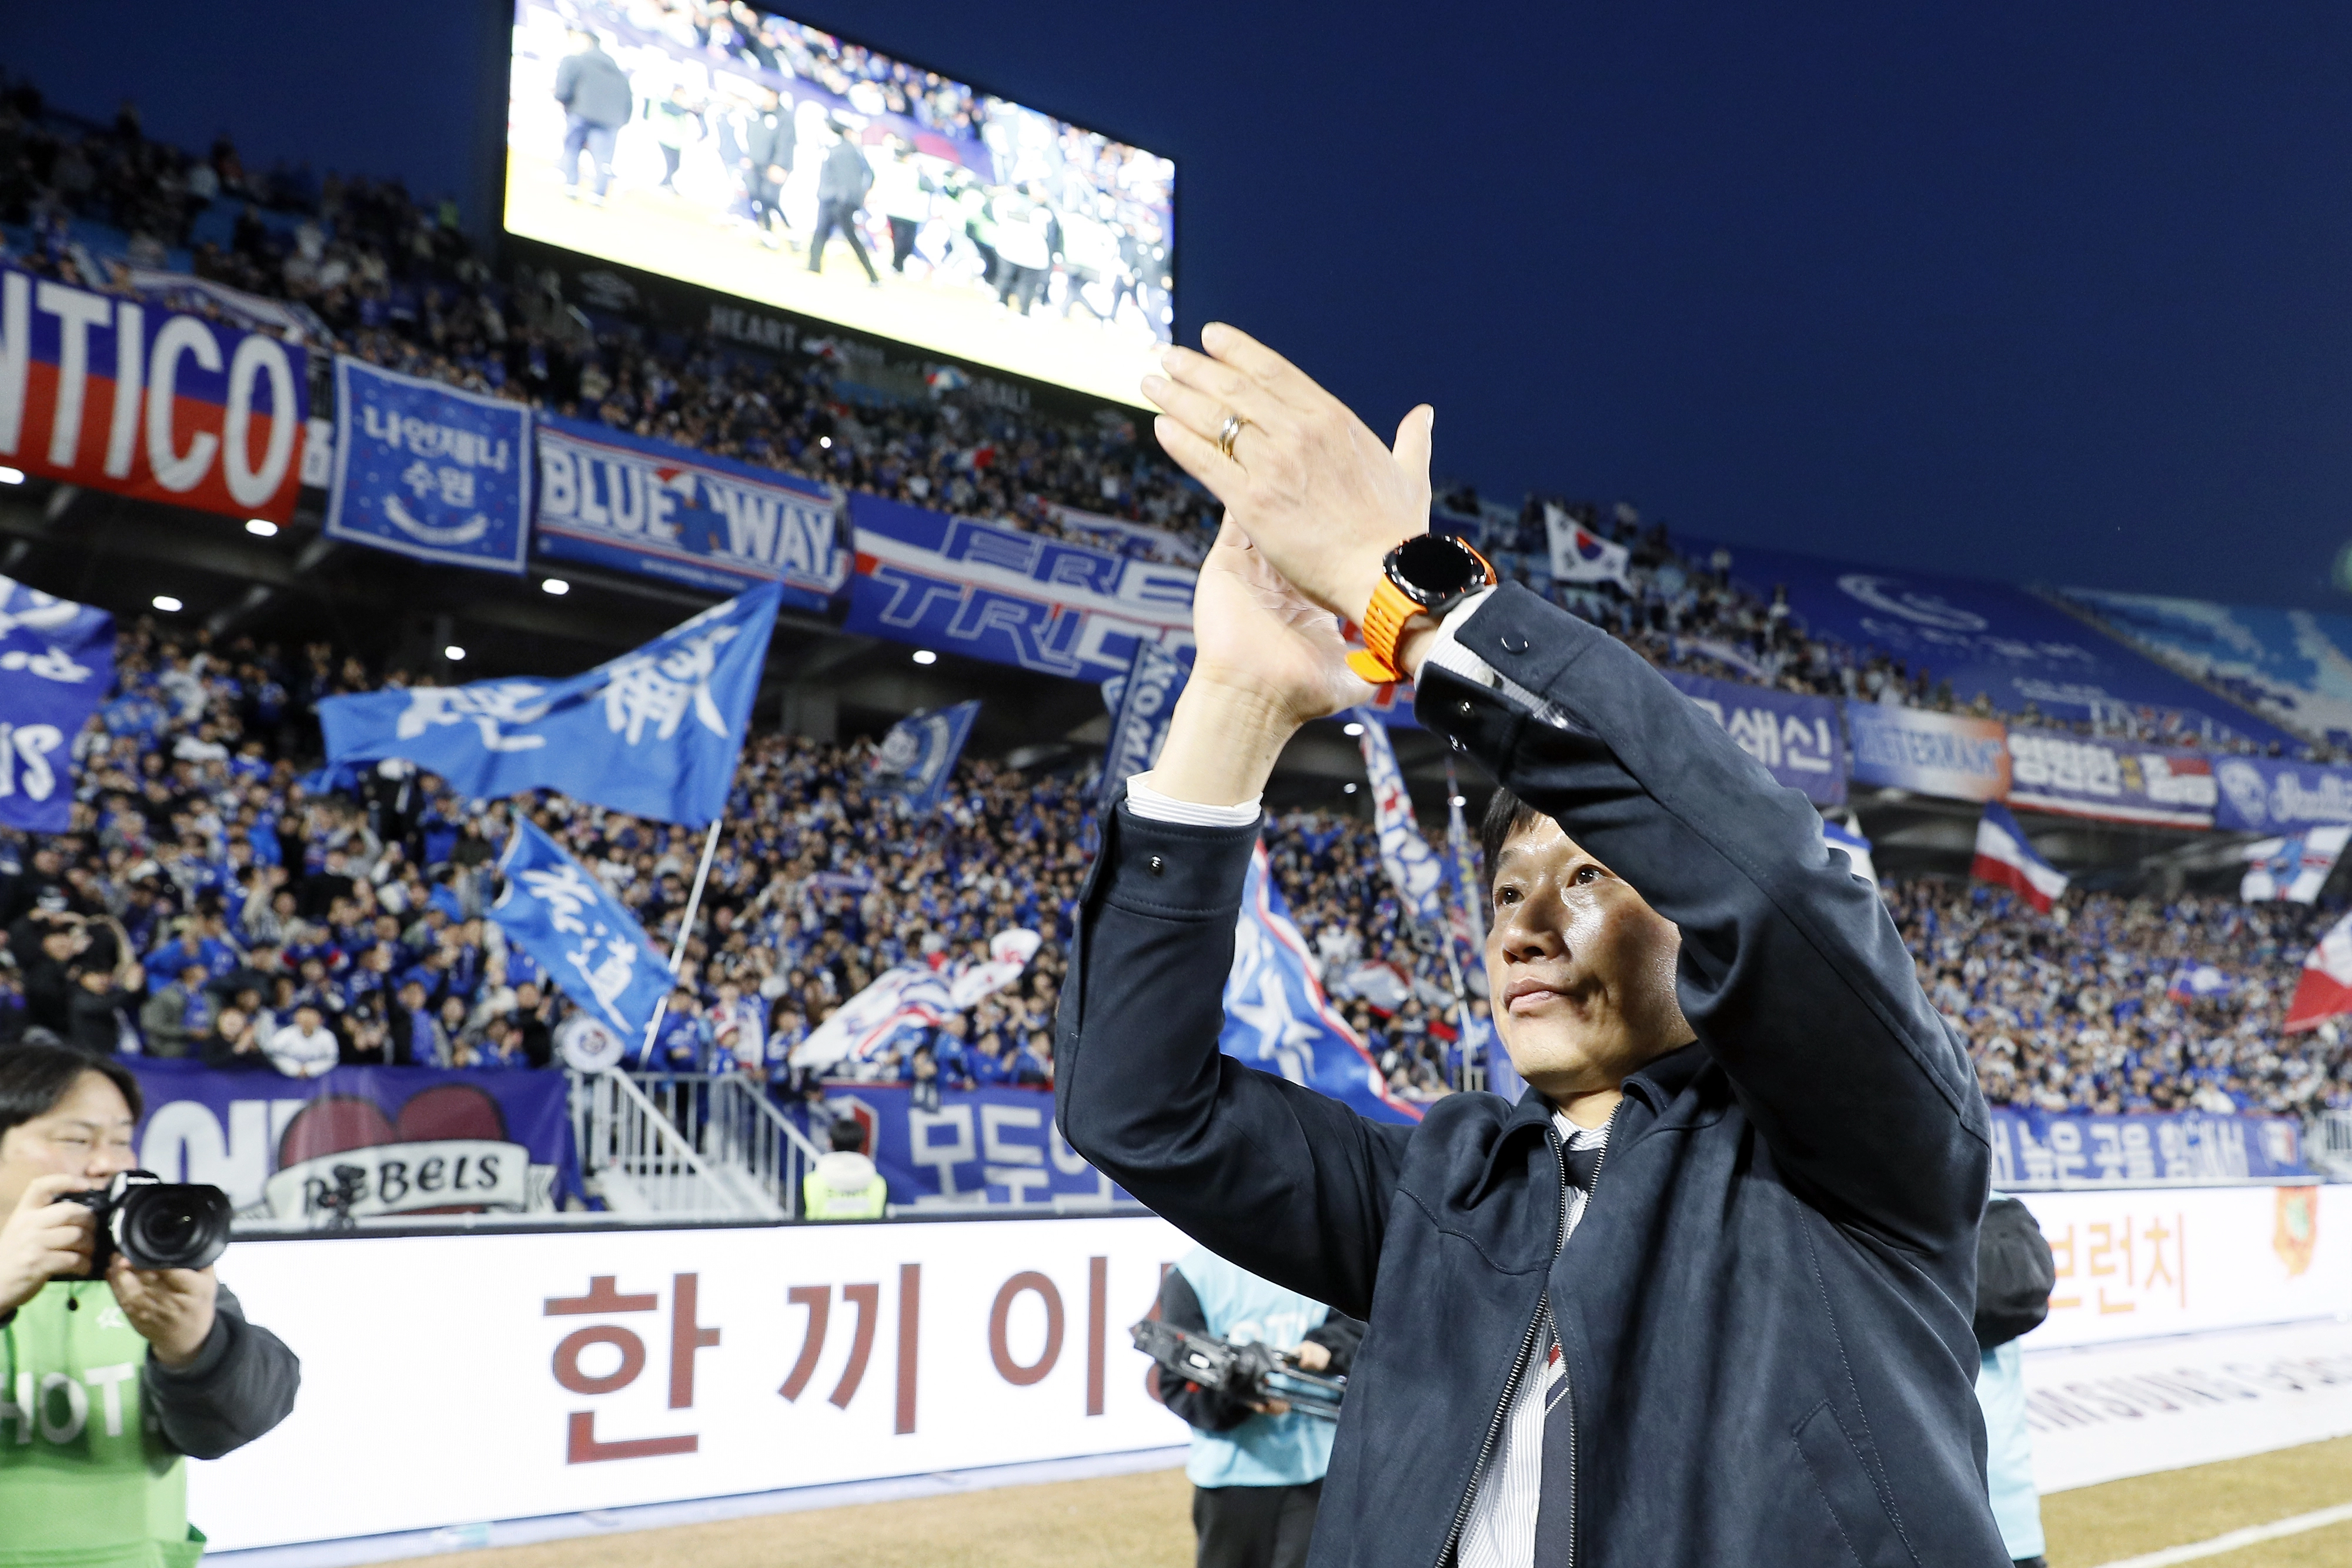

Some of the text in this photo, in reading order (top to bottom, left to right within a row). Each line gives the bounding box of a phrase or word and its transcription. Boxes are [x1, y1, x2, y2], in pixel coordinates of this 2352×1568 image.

[542, 449, 837, 577] BLUE WAY
[873, 561, 1196, 678] TRIC
[1689, 696, 1833, 774] 쇄신
[988, 1256, 1172, 1416] 이
[0, 1361, 158, 1445] HOT
